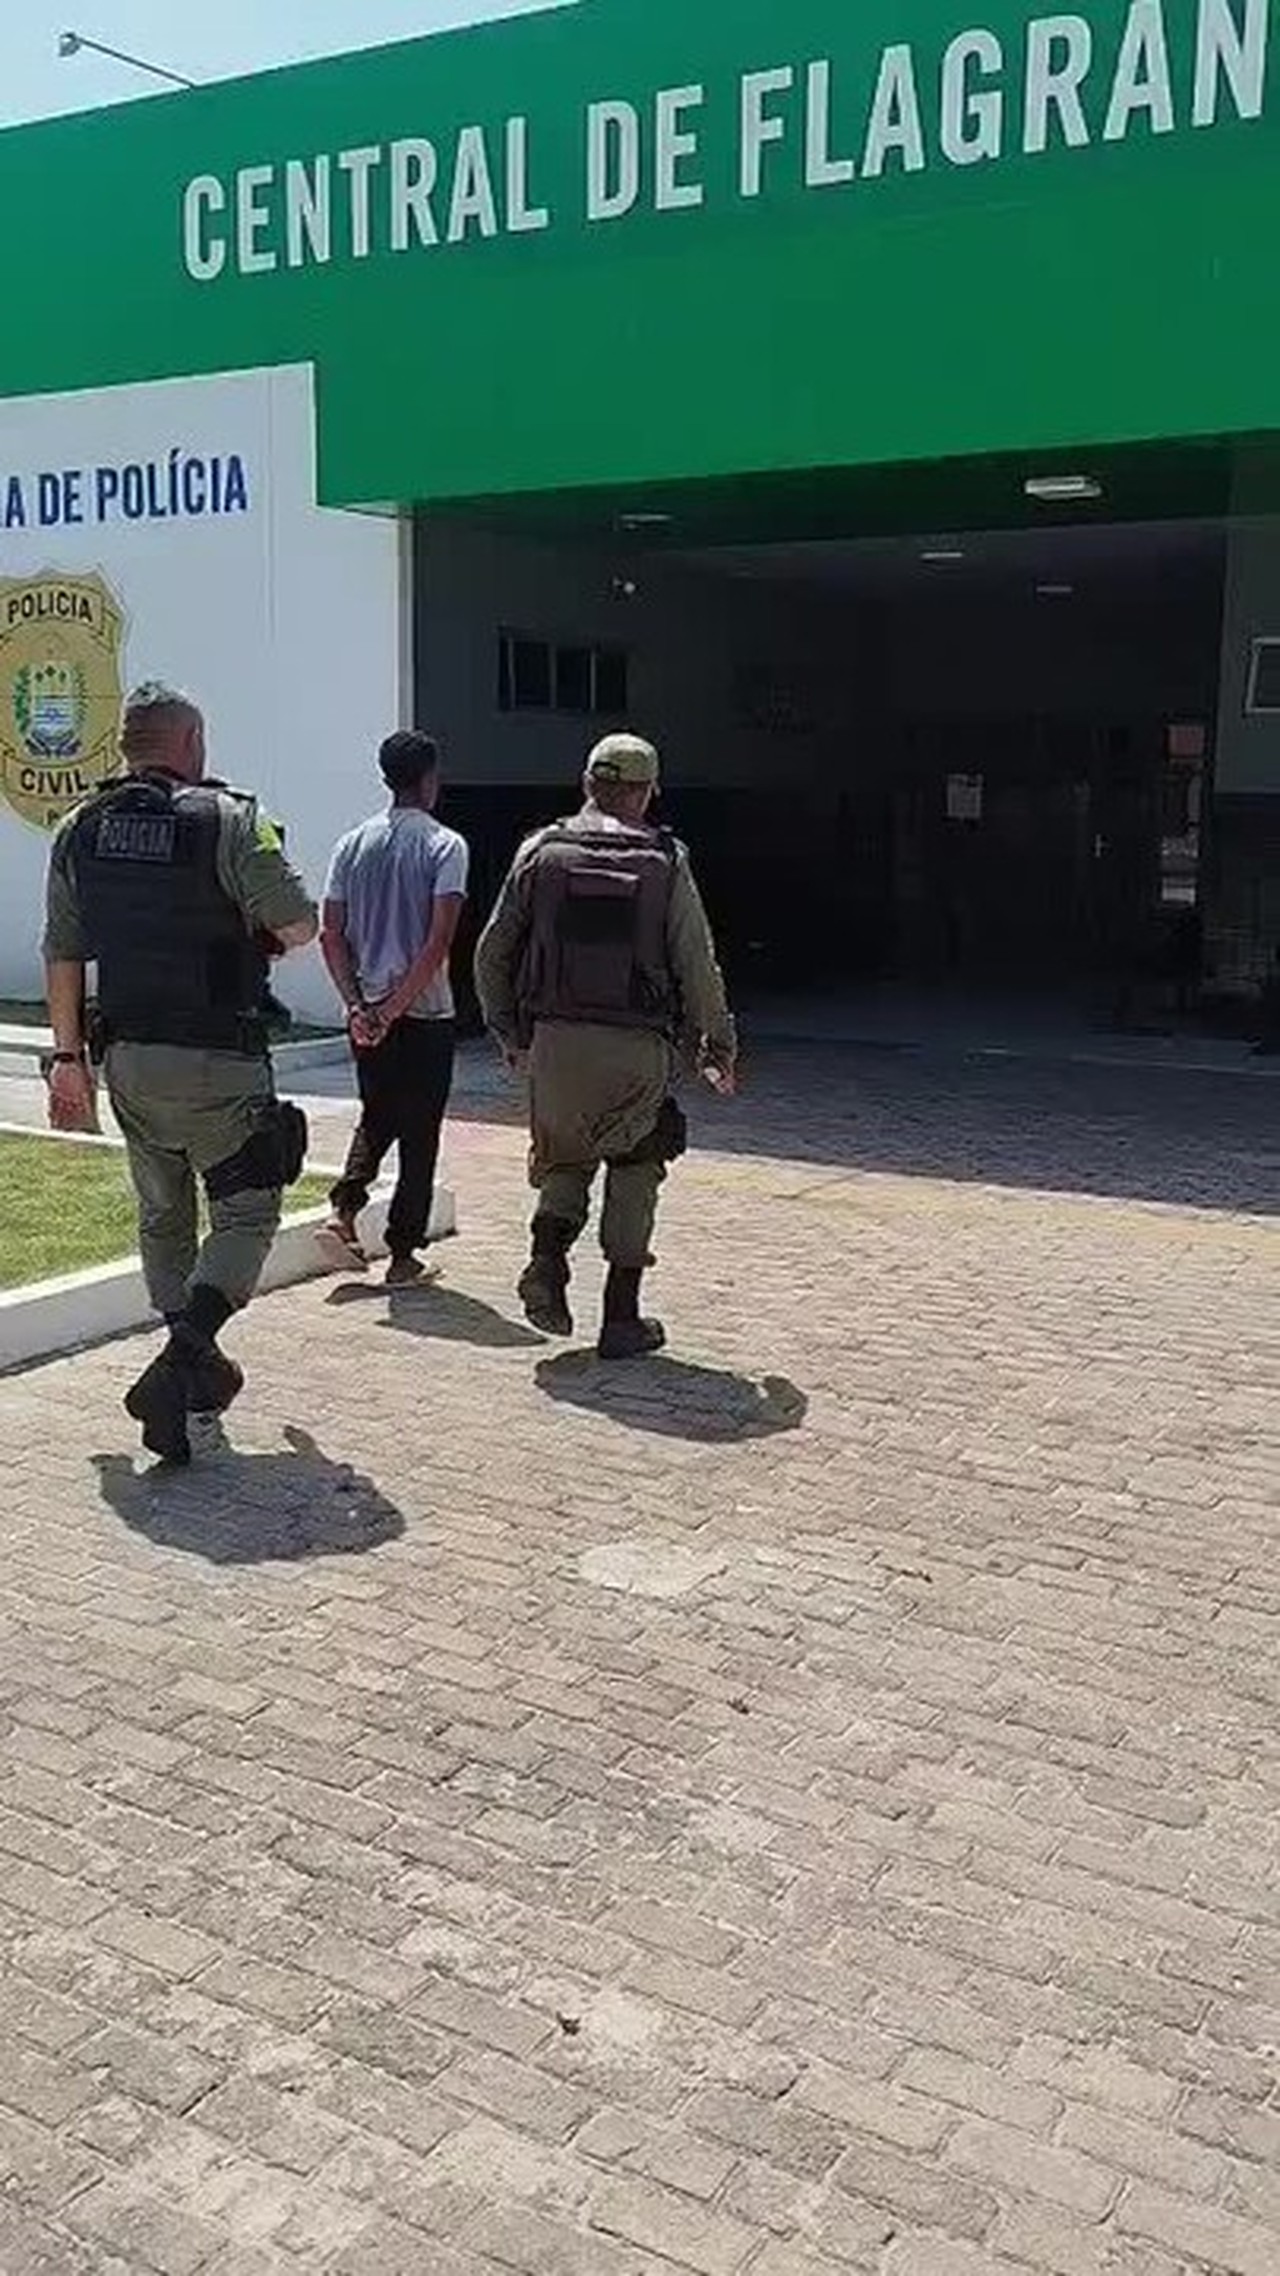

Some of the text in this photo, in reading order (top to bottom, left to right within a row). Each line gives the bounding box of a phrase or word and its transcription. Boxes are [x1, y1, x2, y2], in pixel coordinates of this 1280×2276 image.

[183, 0, 1269, 282] CENTRAL DE FLAGRAN
[38, 473, 84, 526] DE
[97, 448, 248, 522] POLÍCIA
[20, 768, 89, 795] CIVIL
